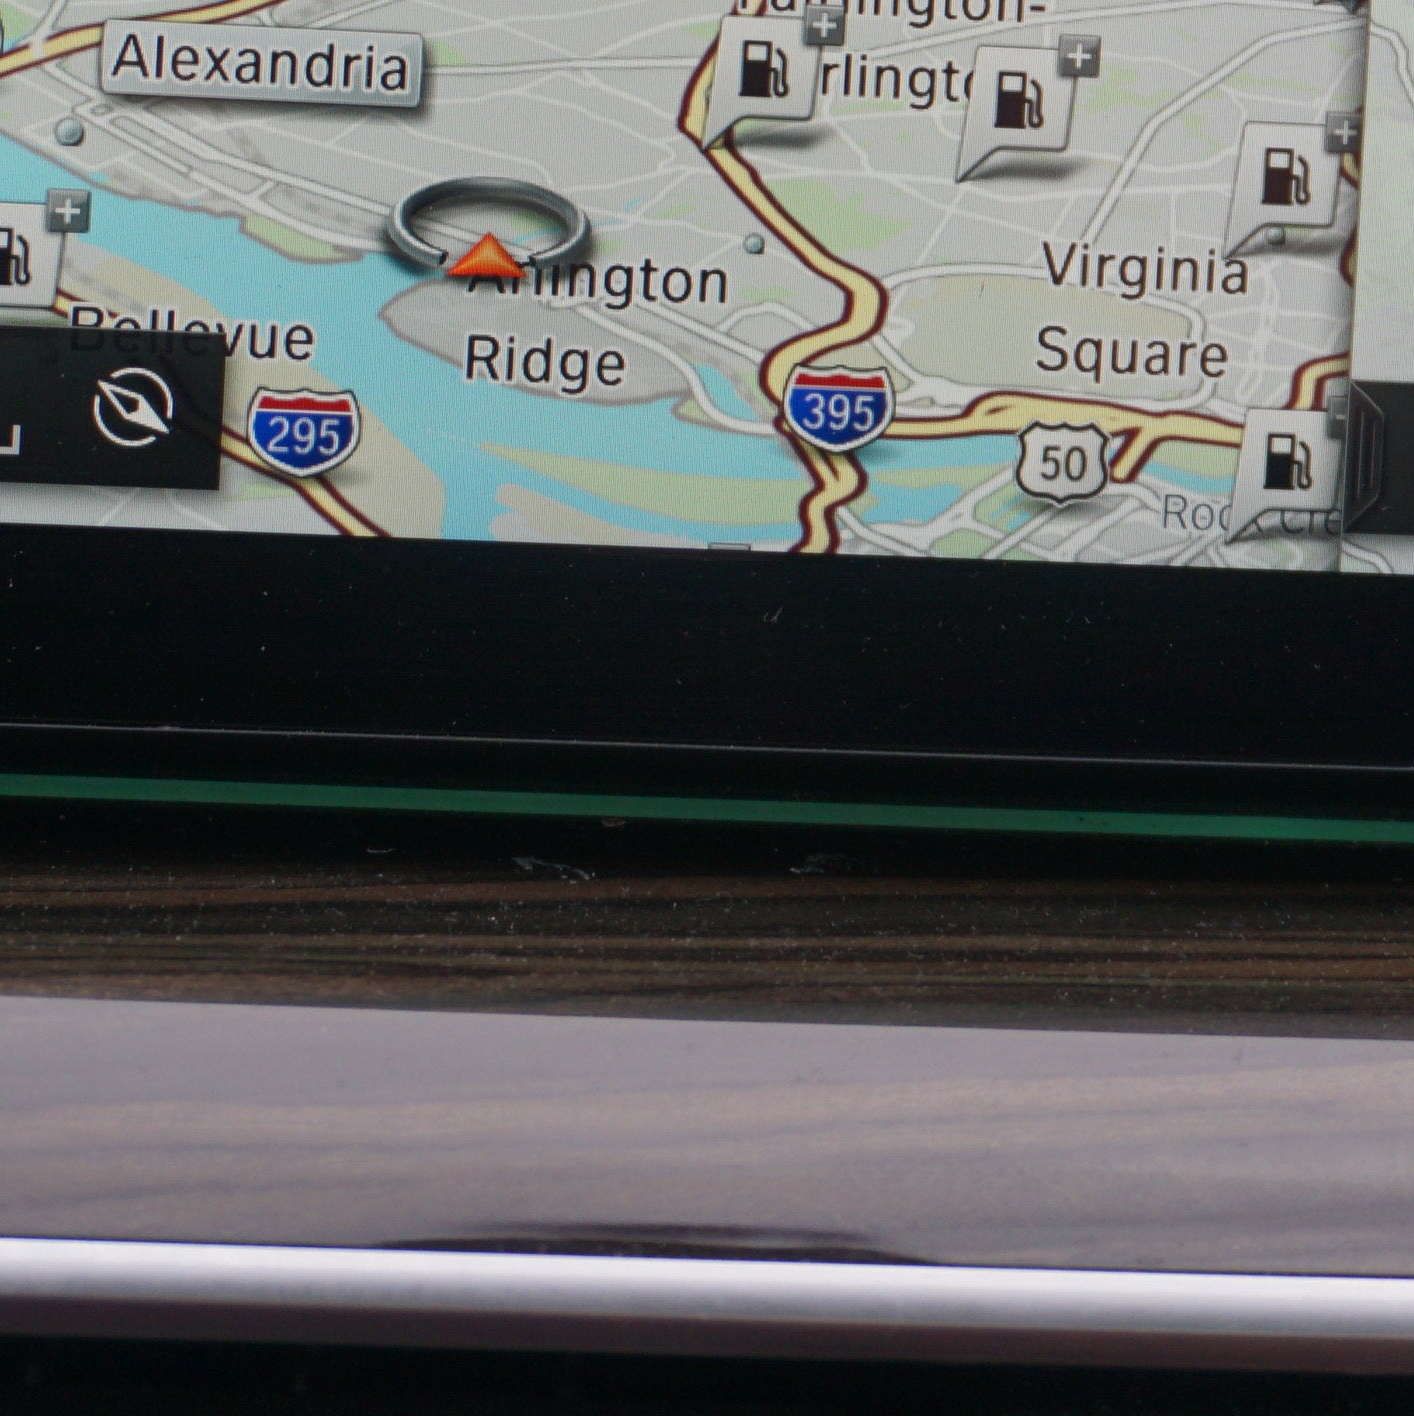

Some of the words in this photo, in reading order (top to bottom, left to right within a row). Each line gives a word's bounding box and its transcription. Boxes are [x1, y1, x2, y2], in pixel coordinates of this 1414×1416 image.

[111, 34, 409, 91] Alexandria
[822, 54, 974, 109] rlingt
[1042, 241, 1249, 299] Virginia
[466, 334, 625, 394] Ridge
[1037, 327, 1229, 383] Square
[267, 417, 340, 457] 295
[802, 394, 875, 434] 395
[1040, 446, 1086, 482] 50
[1163, 493, 1263, 533] Roc
